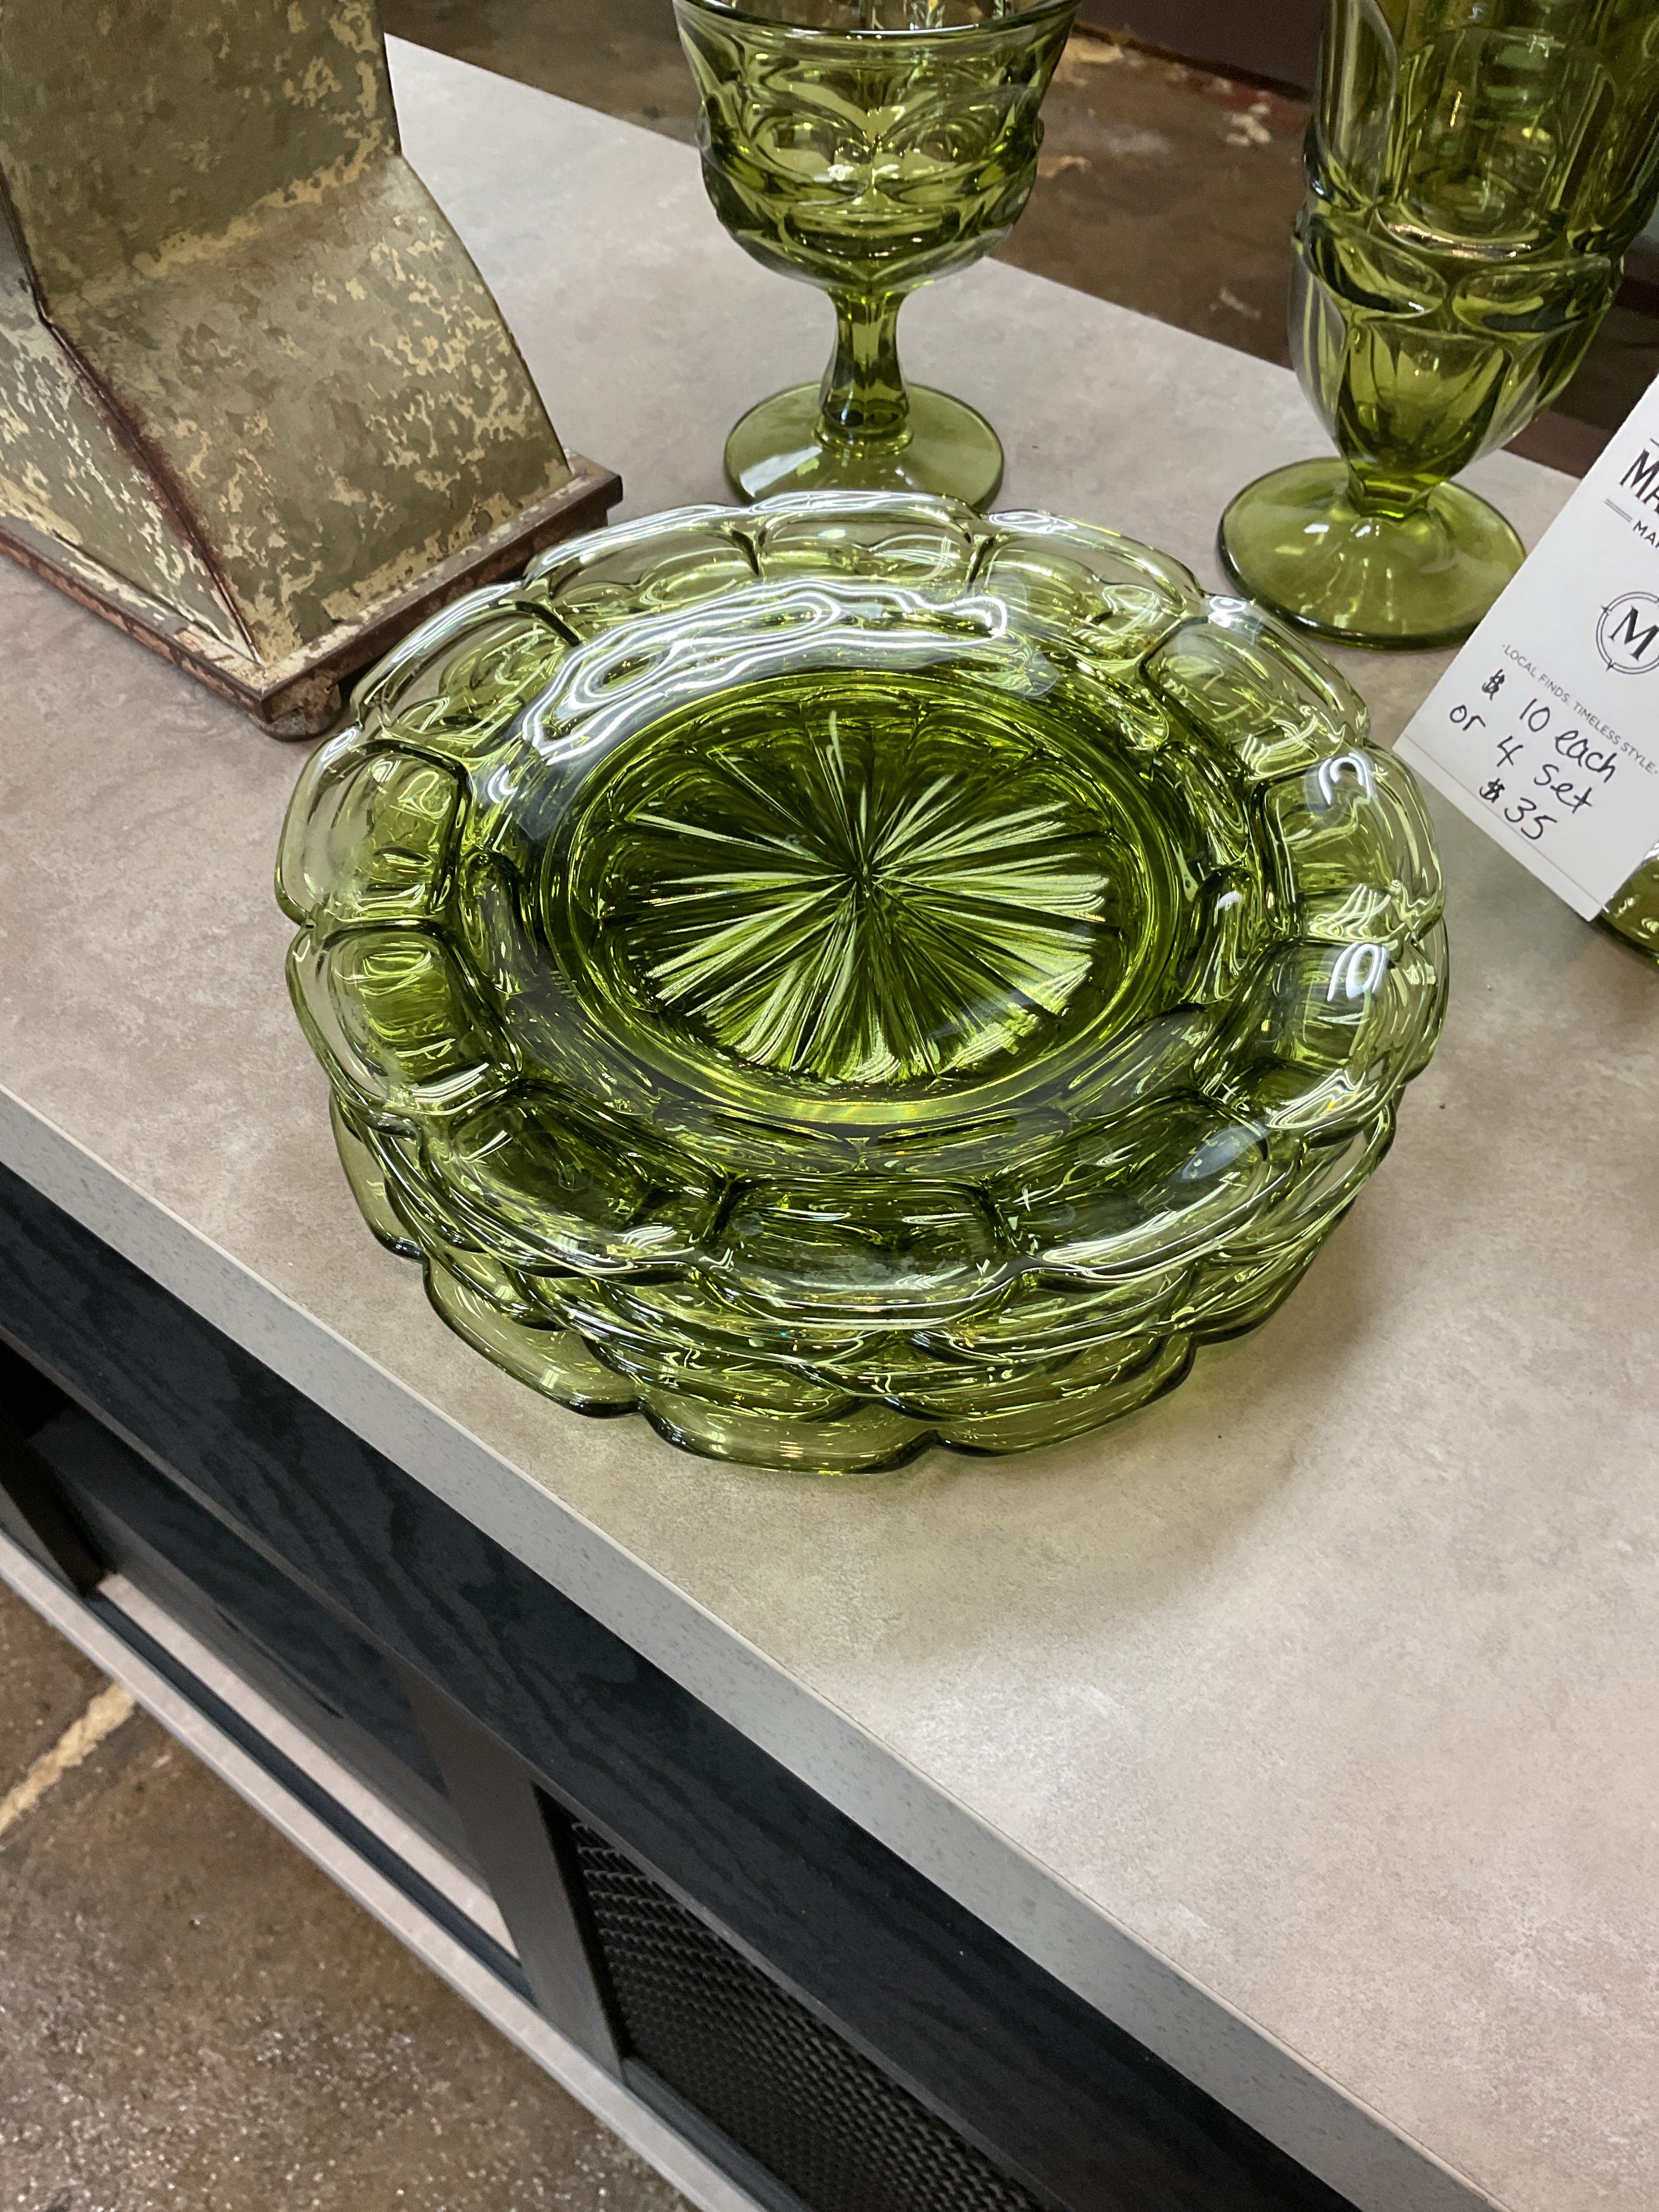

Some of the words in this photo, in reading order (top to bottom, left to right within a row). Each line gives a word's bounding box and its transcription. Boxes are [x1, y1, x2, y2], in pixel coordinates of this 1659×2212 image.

[1632, 520, 1659, 549] MA
[1482, 669, 1505, 701] $
[1519, 698, 1550, 732] 10
[1554, 730, 1617, 783] each
[1504, 644, 1536, 678] LOCAL
[1538, 673, 1570, 706] FINDS.
[1573, 701, 1622, 745] TIMELESS
[1449, 704, 1486, 731] or
[1497, 736, 1523, 768] 4
